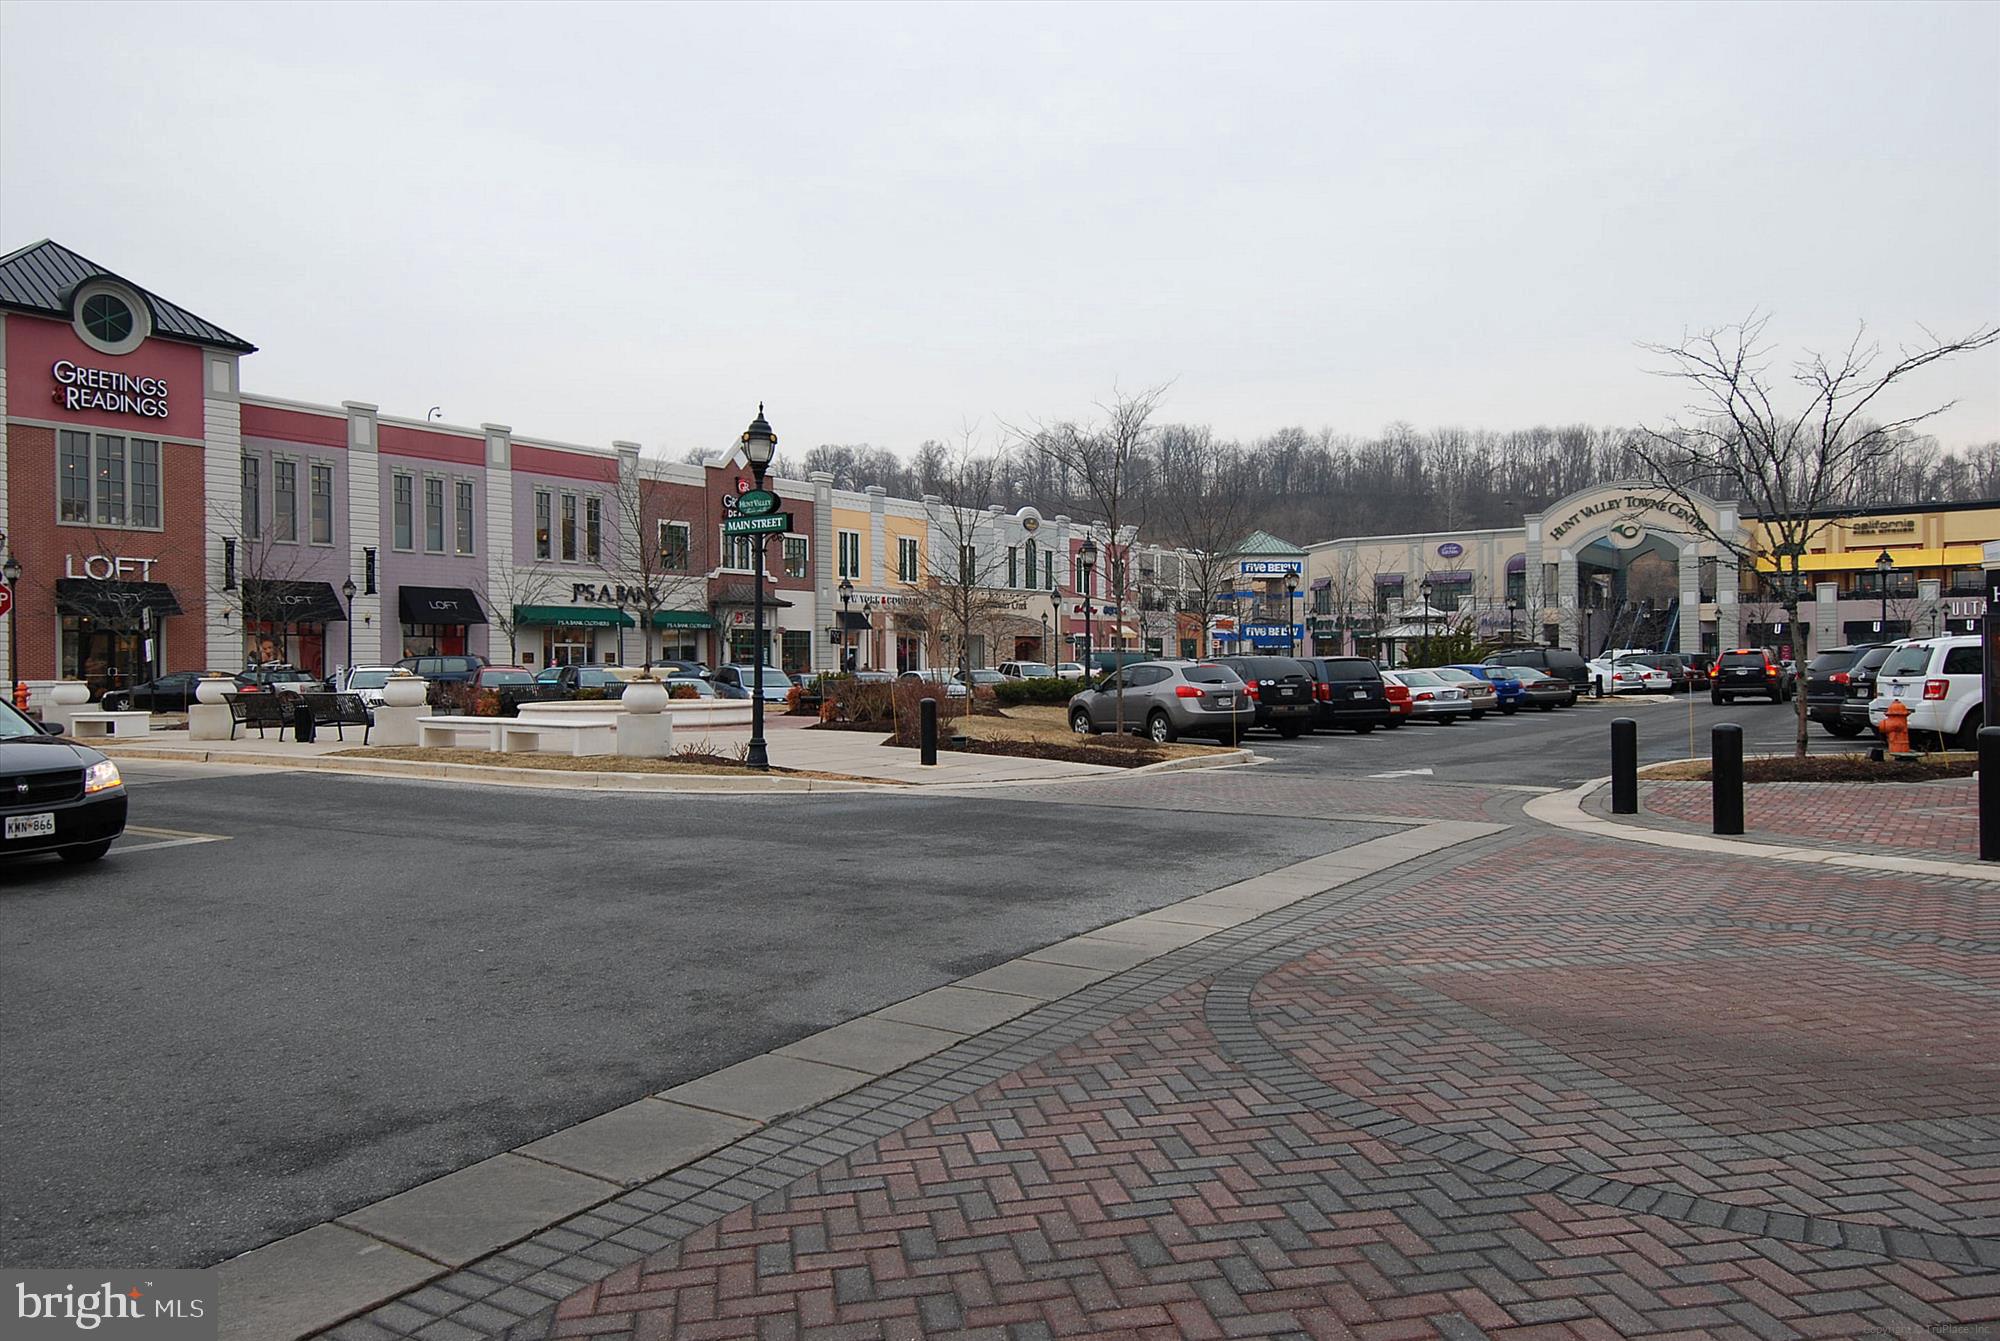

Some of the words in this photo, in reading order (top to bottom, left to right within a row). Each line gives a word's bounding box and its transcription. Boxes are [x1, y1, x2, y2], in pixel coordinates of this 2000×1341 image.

[53, 360, 168, 398] GREETINGS
[66, 386, 169, 418] READINGS
[728, 520, 750, 531] MAIN
[751, 518, 783, 529] STREET
[1550, 513, 1581, 541] HUNT
[1579, 498, 1623, 518] VALLEY
[1624, 496, 1667, 512] TOWNE
[1668, 503, 1708, 533] CENTRE
[66, 554, 159, 582] LOFT
[276, 595, 313, 606] LOFT
[428, 600, 458, 610] LOFT
[1952, 600, 1988, 616] ULTA
[1774, 623, 1782, 634] U
[1873, 621, 1881, 632] U
[1966, 619, 1975, 631] U
